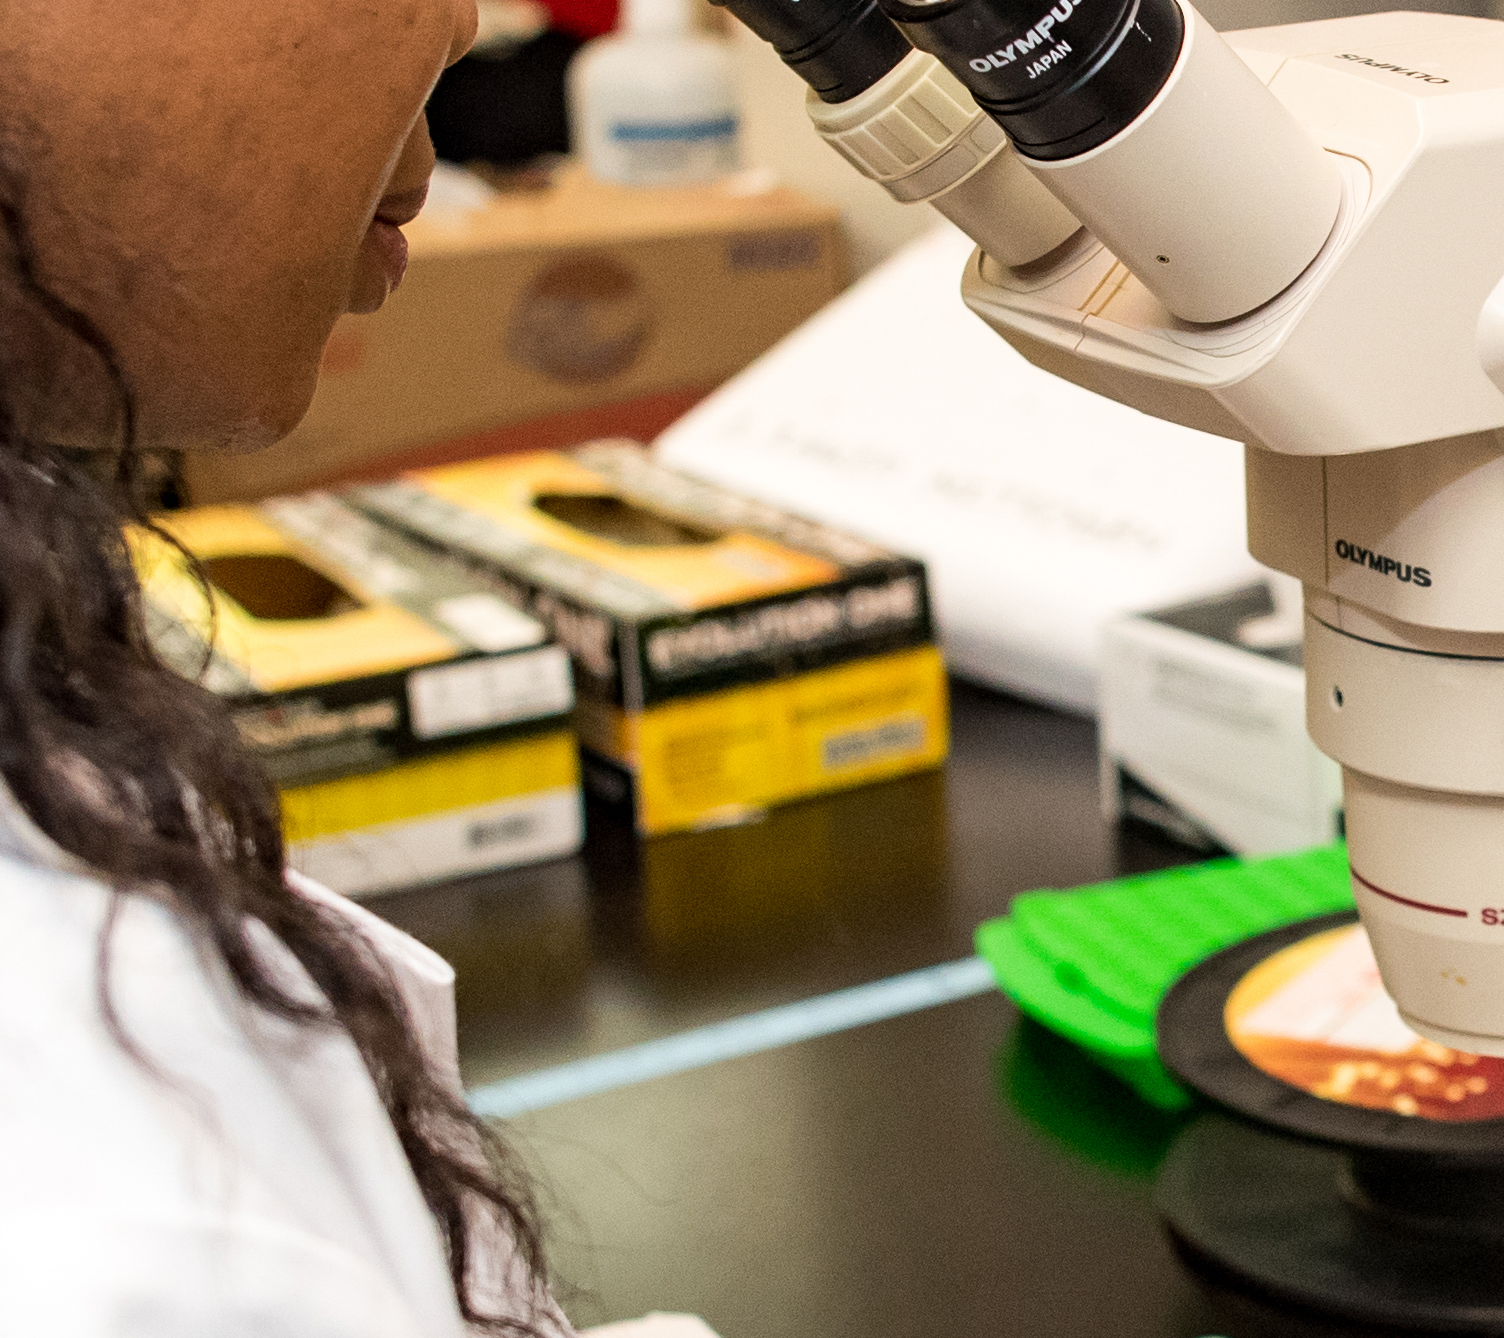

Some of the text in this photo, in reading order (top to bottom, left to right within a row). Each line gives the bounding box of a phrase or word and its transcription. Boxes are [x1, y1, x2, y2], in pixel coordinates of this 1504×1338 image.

[1026, 39, 1073, 79] JAPAN
[1334, 53, 1450, 84] OLYMPUS
[1335, 539, 1432, 588] OLYMPUS
